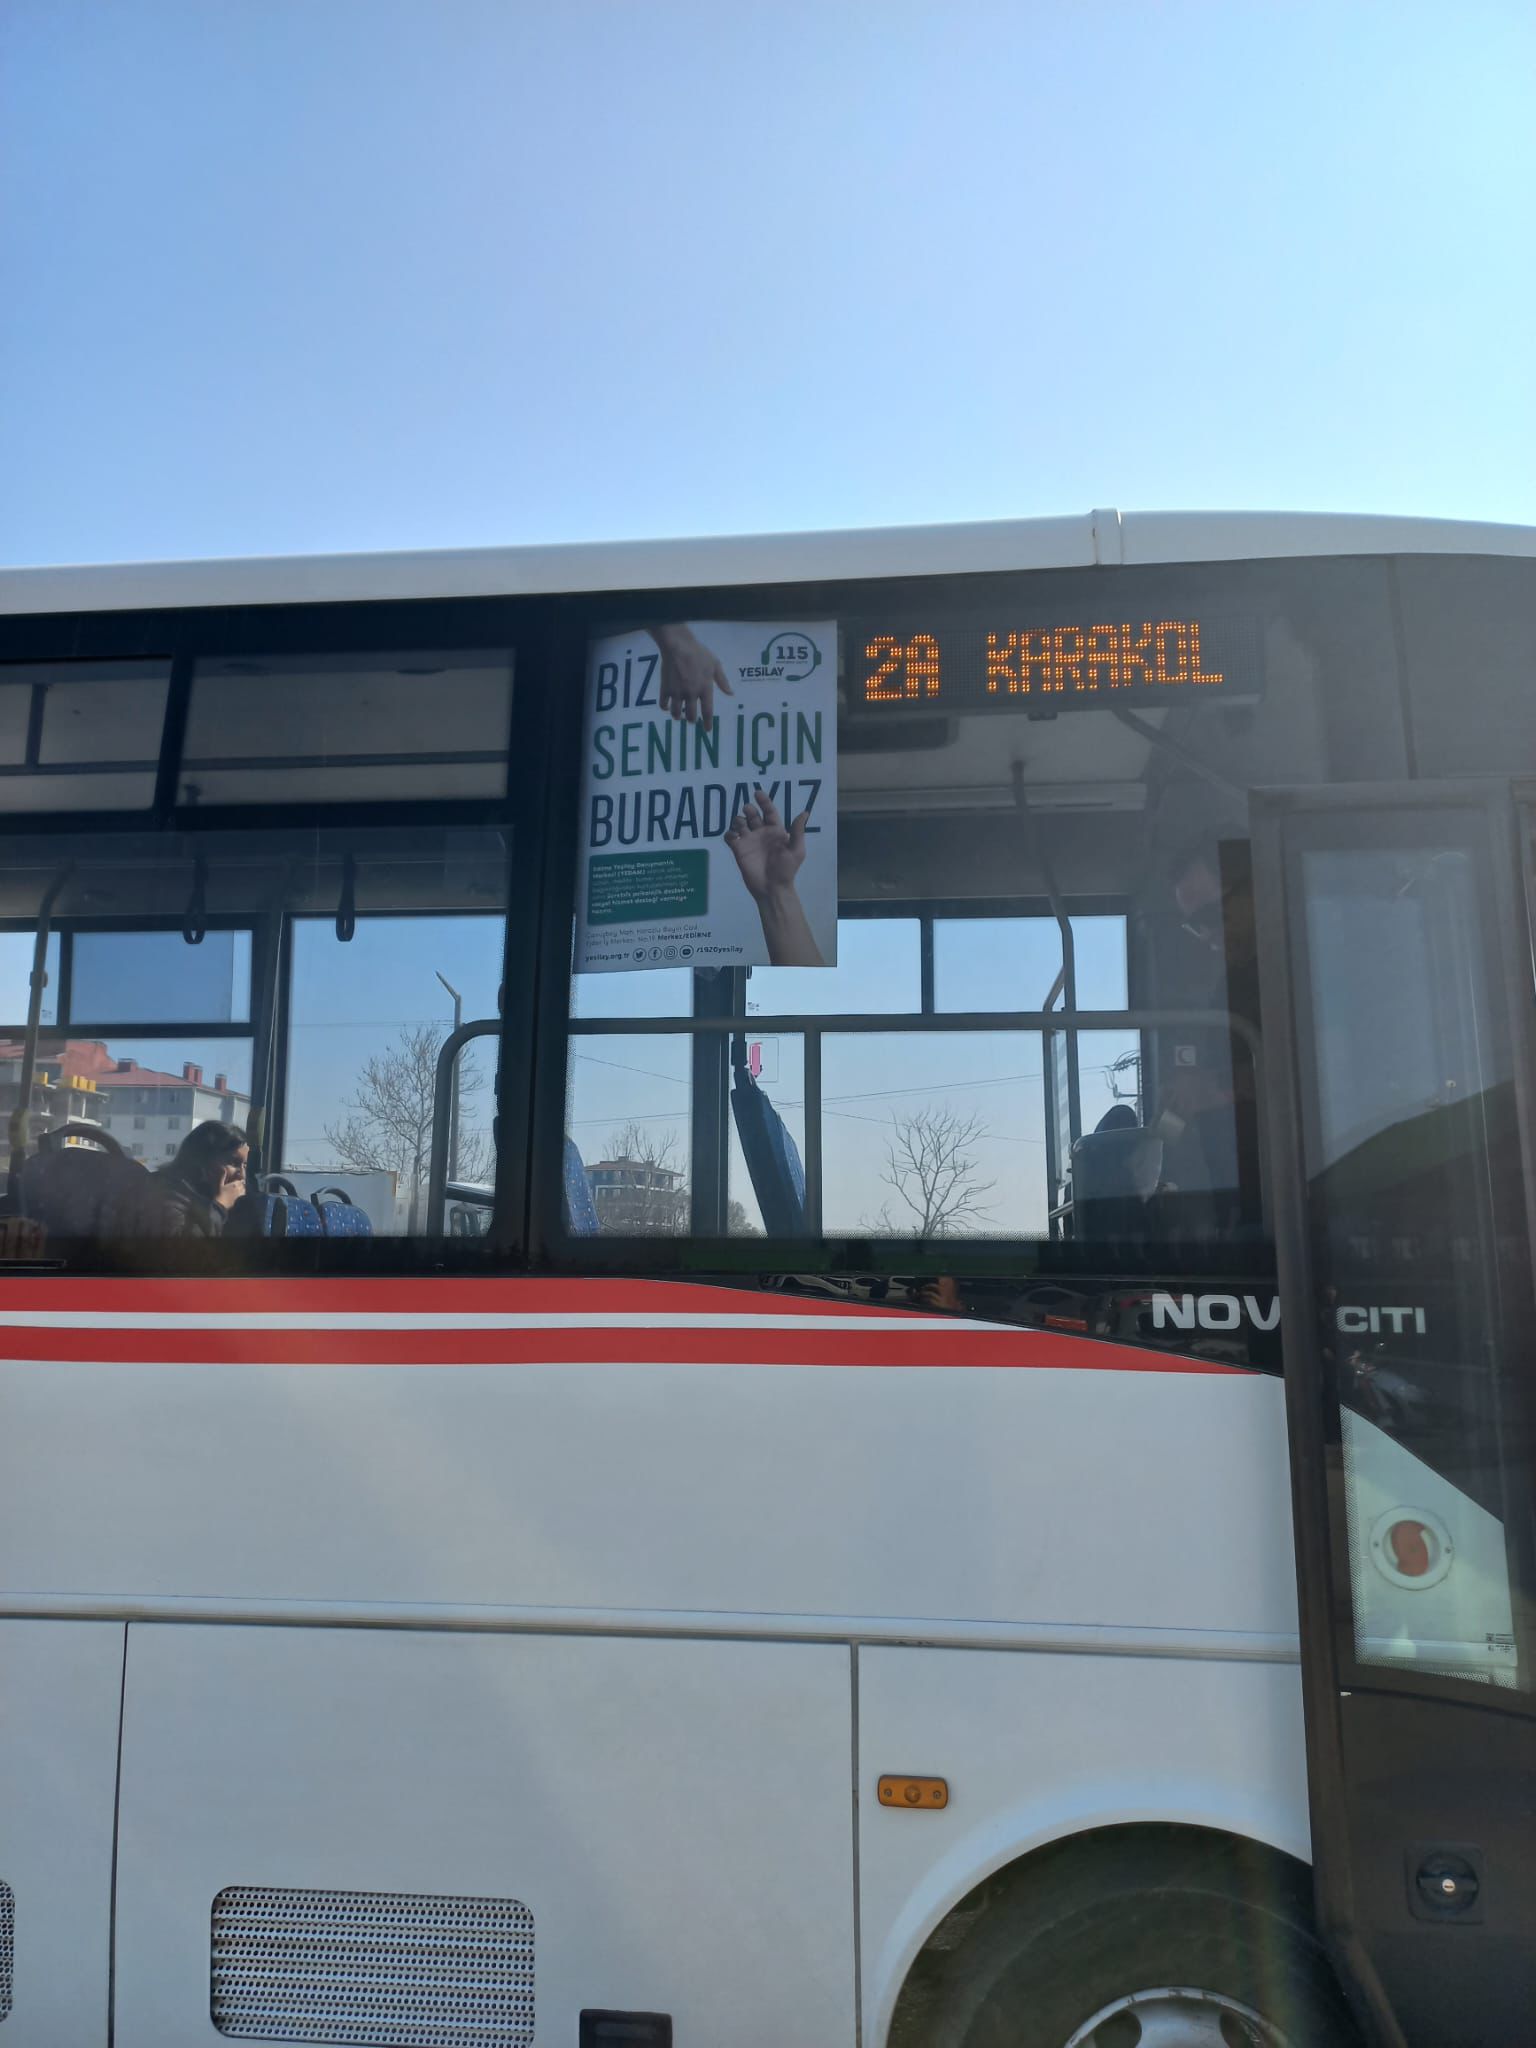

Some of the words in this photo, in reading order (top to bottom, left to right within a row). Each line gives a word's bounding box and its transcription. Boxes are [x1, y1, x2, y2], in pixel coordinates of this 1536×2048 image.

[595, 649, 659, 713] BİZ
[775, 645, 809, 660] 115
[864, 633, 941, 701] 2A
[986, 620, 1224, 694] KARAKOL
[592, 705, 720, 780] SENİN
[736, 701, 823, 775] İÇİN
[1336, 1306, 1427, 1334] CITI
